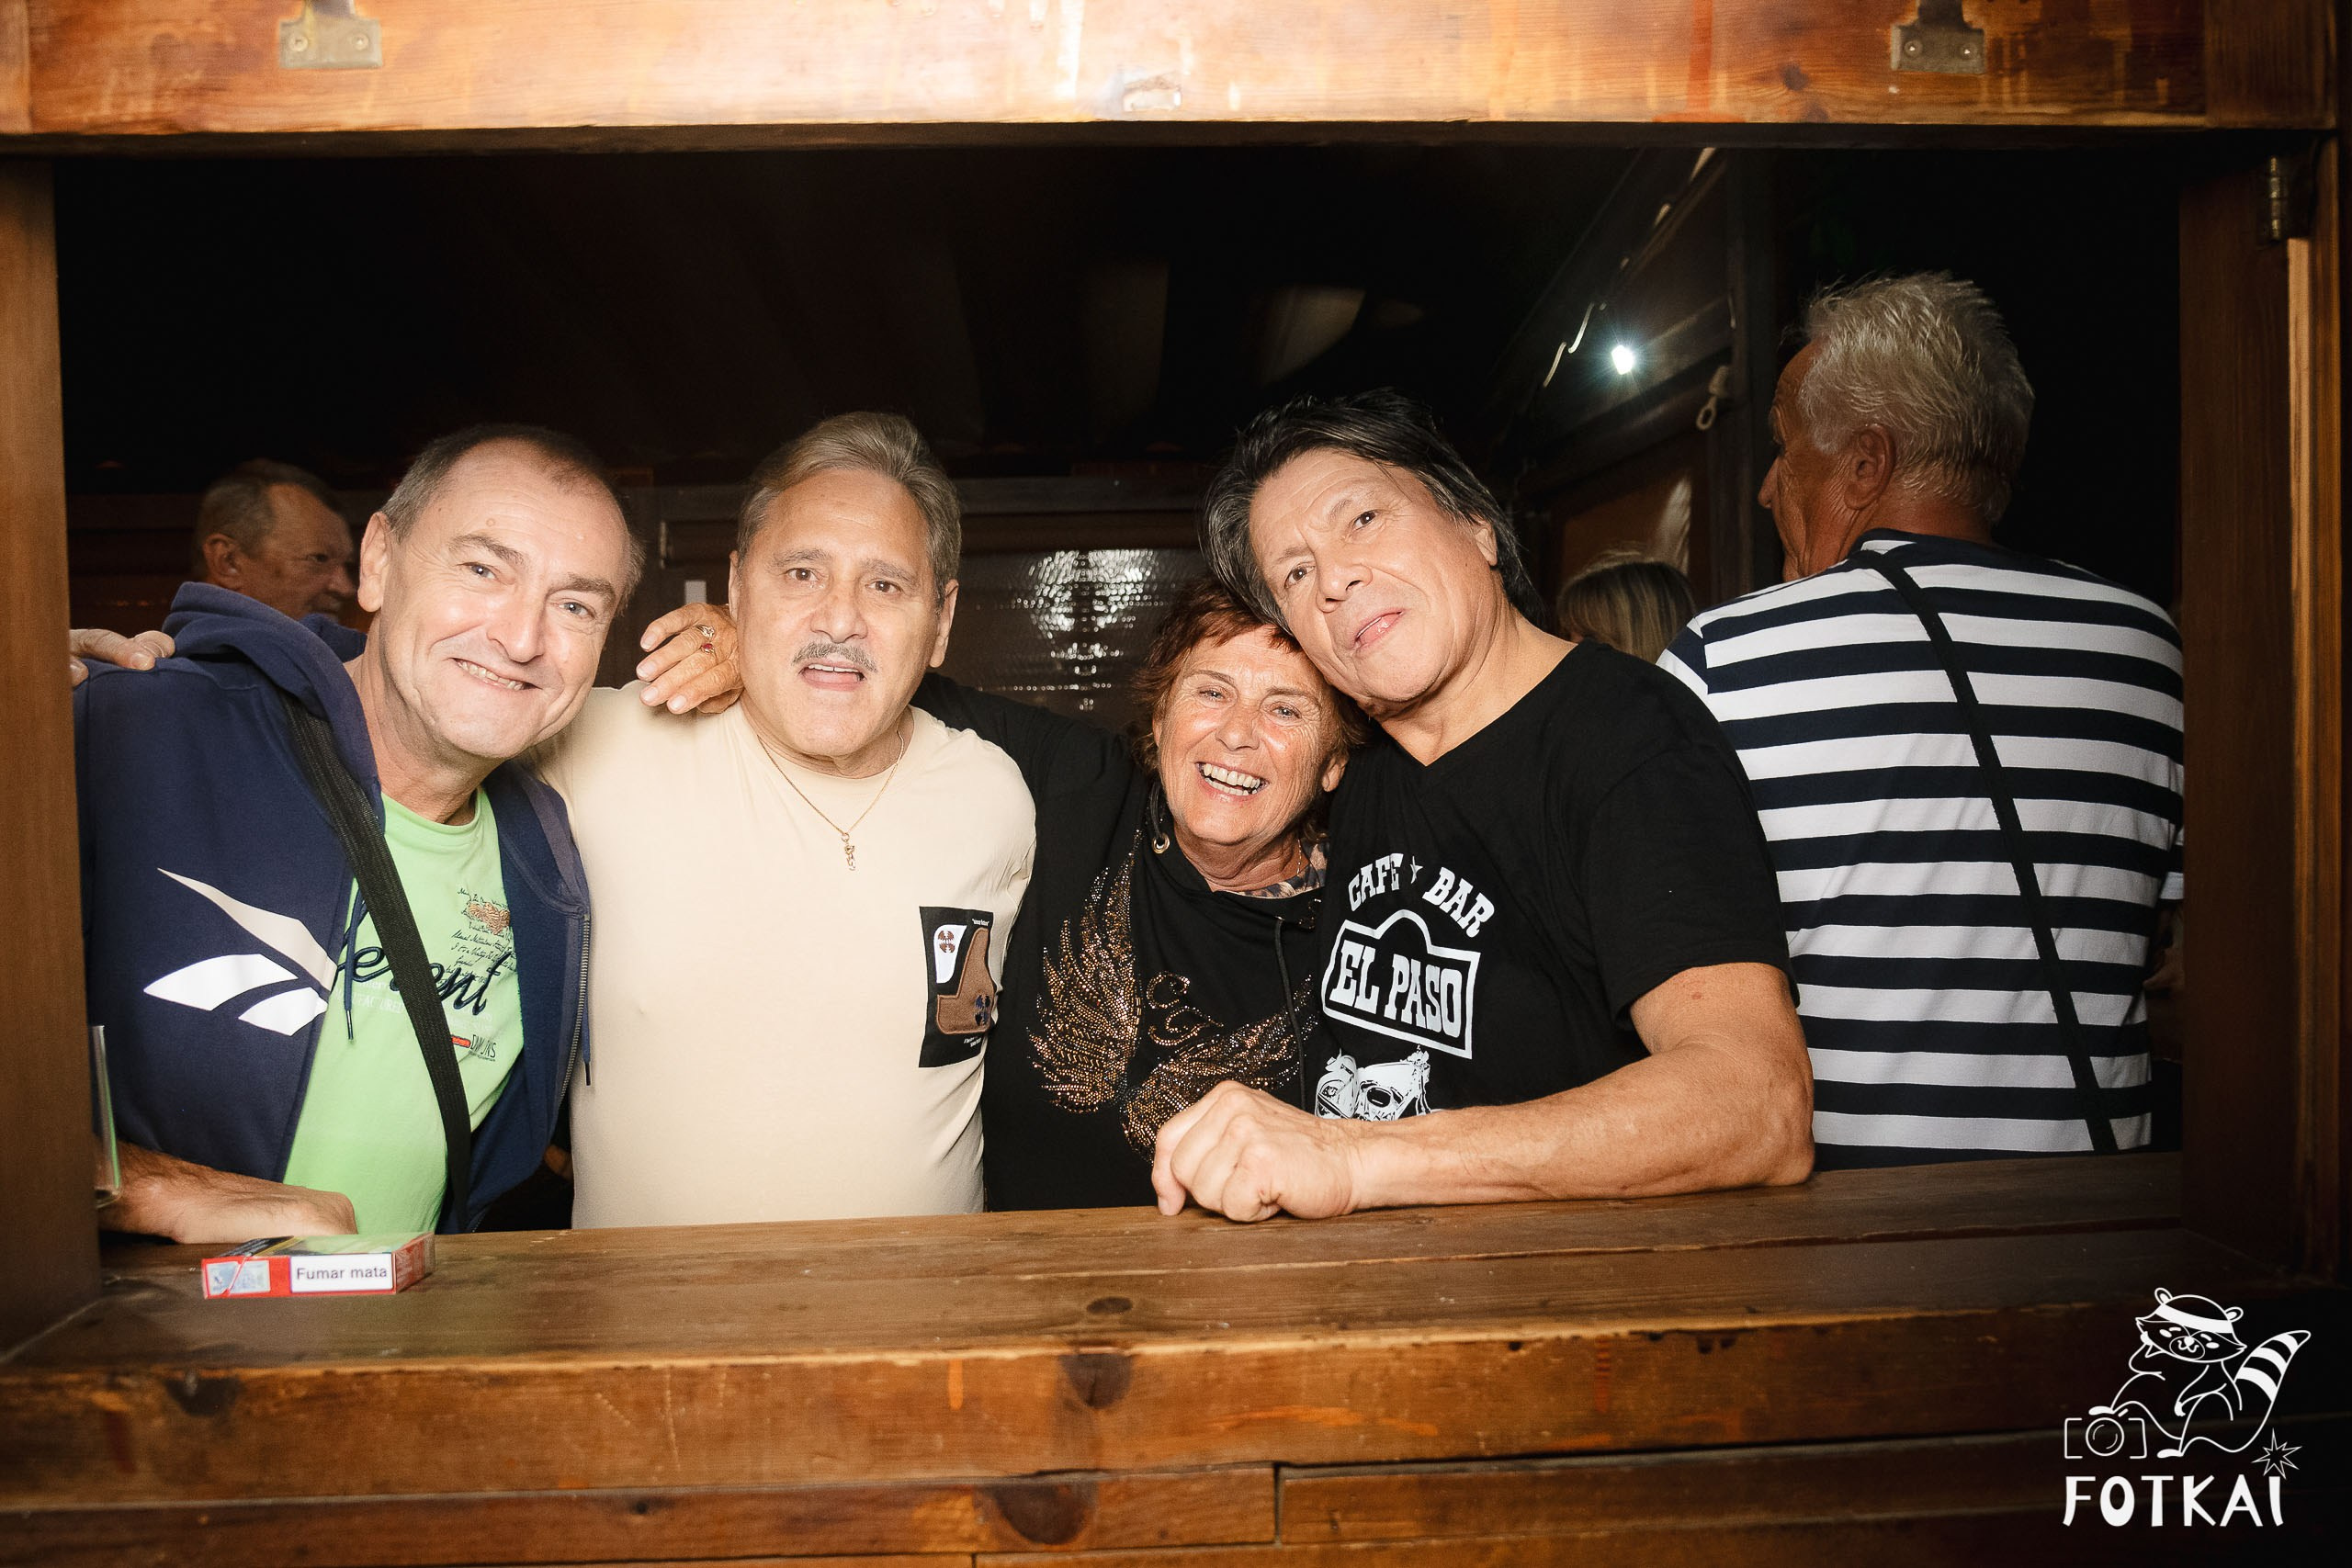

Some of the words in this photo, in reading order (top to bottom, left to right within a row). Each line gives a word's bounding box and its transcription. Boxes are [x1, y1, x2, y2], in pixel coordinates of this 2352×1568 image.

[1422, 866, 1495, 938] BAR
[1329, 940, 1380, 1015] EL
[1384, 953, 1463, 1038] PASO
[297, 1268, 345, 1280] Fumar
[351, 1267, 388, 1279] mata
